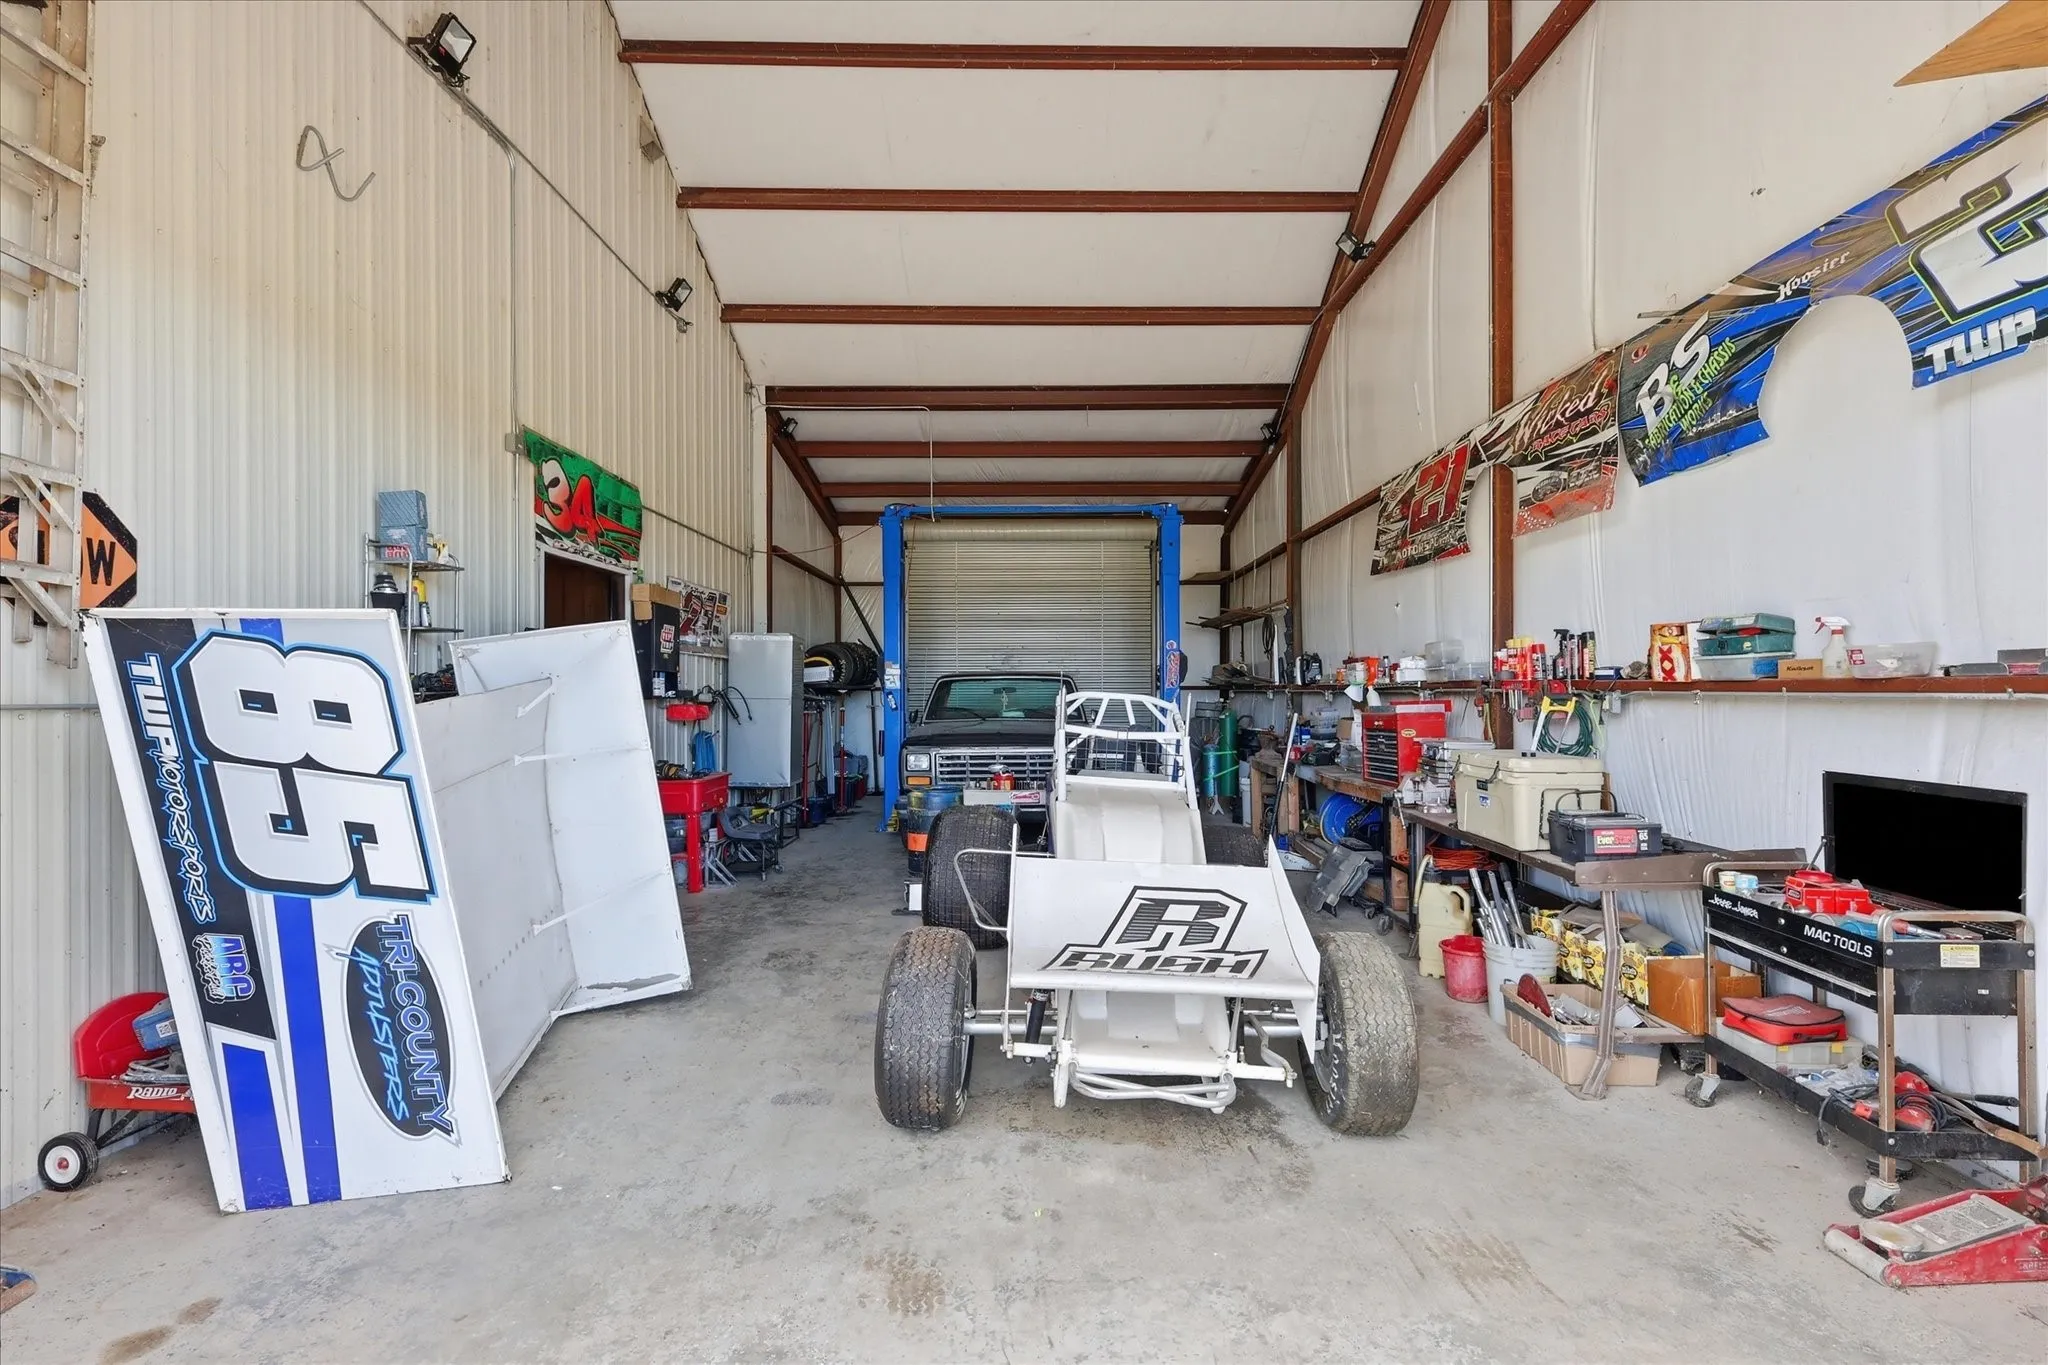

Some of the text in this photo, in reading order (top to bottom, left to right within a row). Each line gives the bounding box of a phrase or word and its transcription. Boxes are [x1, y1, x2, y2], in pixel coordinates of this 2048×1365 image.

[1775, 251, 1850, 303] Hoosier
[1697, 337, 1736, 384] CHASSIS
[1923, 307, 2037, 375] TWP
[1513, 364, 1612, 454] Wicked
[1679, 392, 1713, 432] WORKS
[541, 457, 604, 545] 34
[1408, 440, 1470, 537] 21
[129, 655, 180, 757] TWP
[185, 633, 433, 895] 85
[151, 750, 216, 923] MOTORSPORTS
[205, 935, 254, 997] ABC
[1054, 949, 1258, 977] RUSH
[1803, 924, 1873, 958] MAC TOOLS
[338, 946, 409, 1121] ADJUSTERS
[378, 916, 451, 1131] TRI-COUNTY
